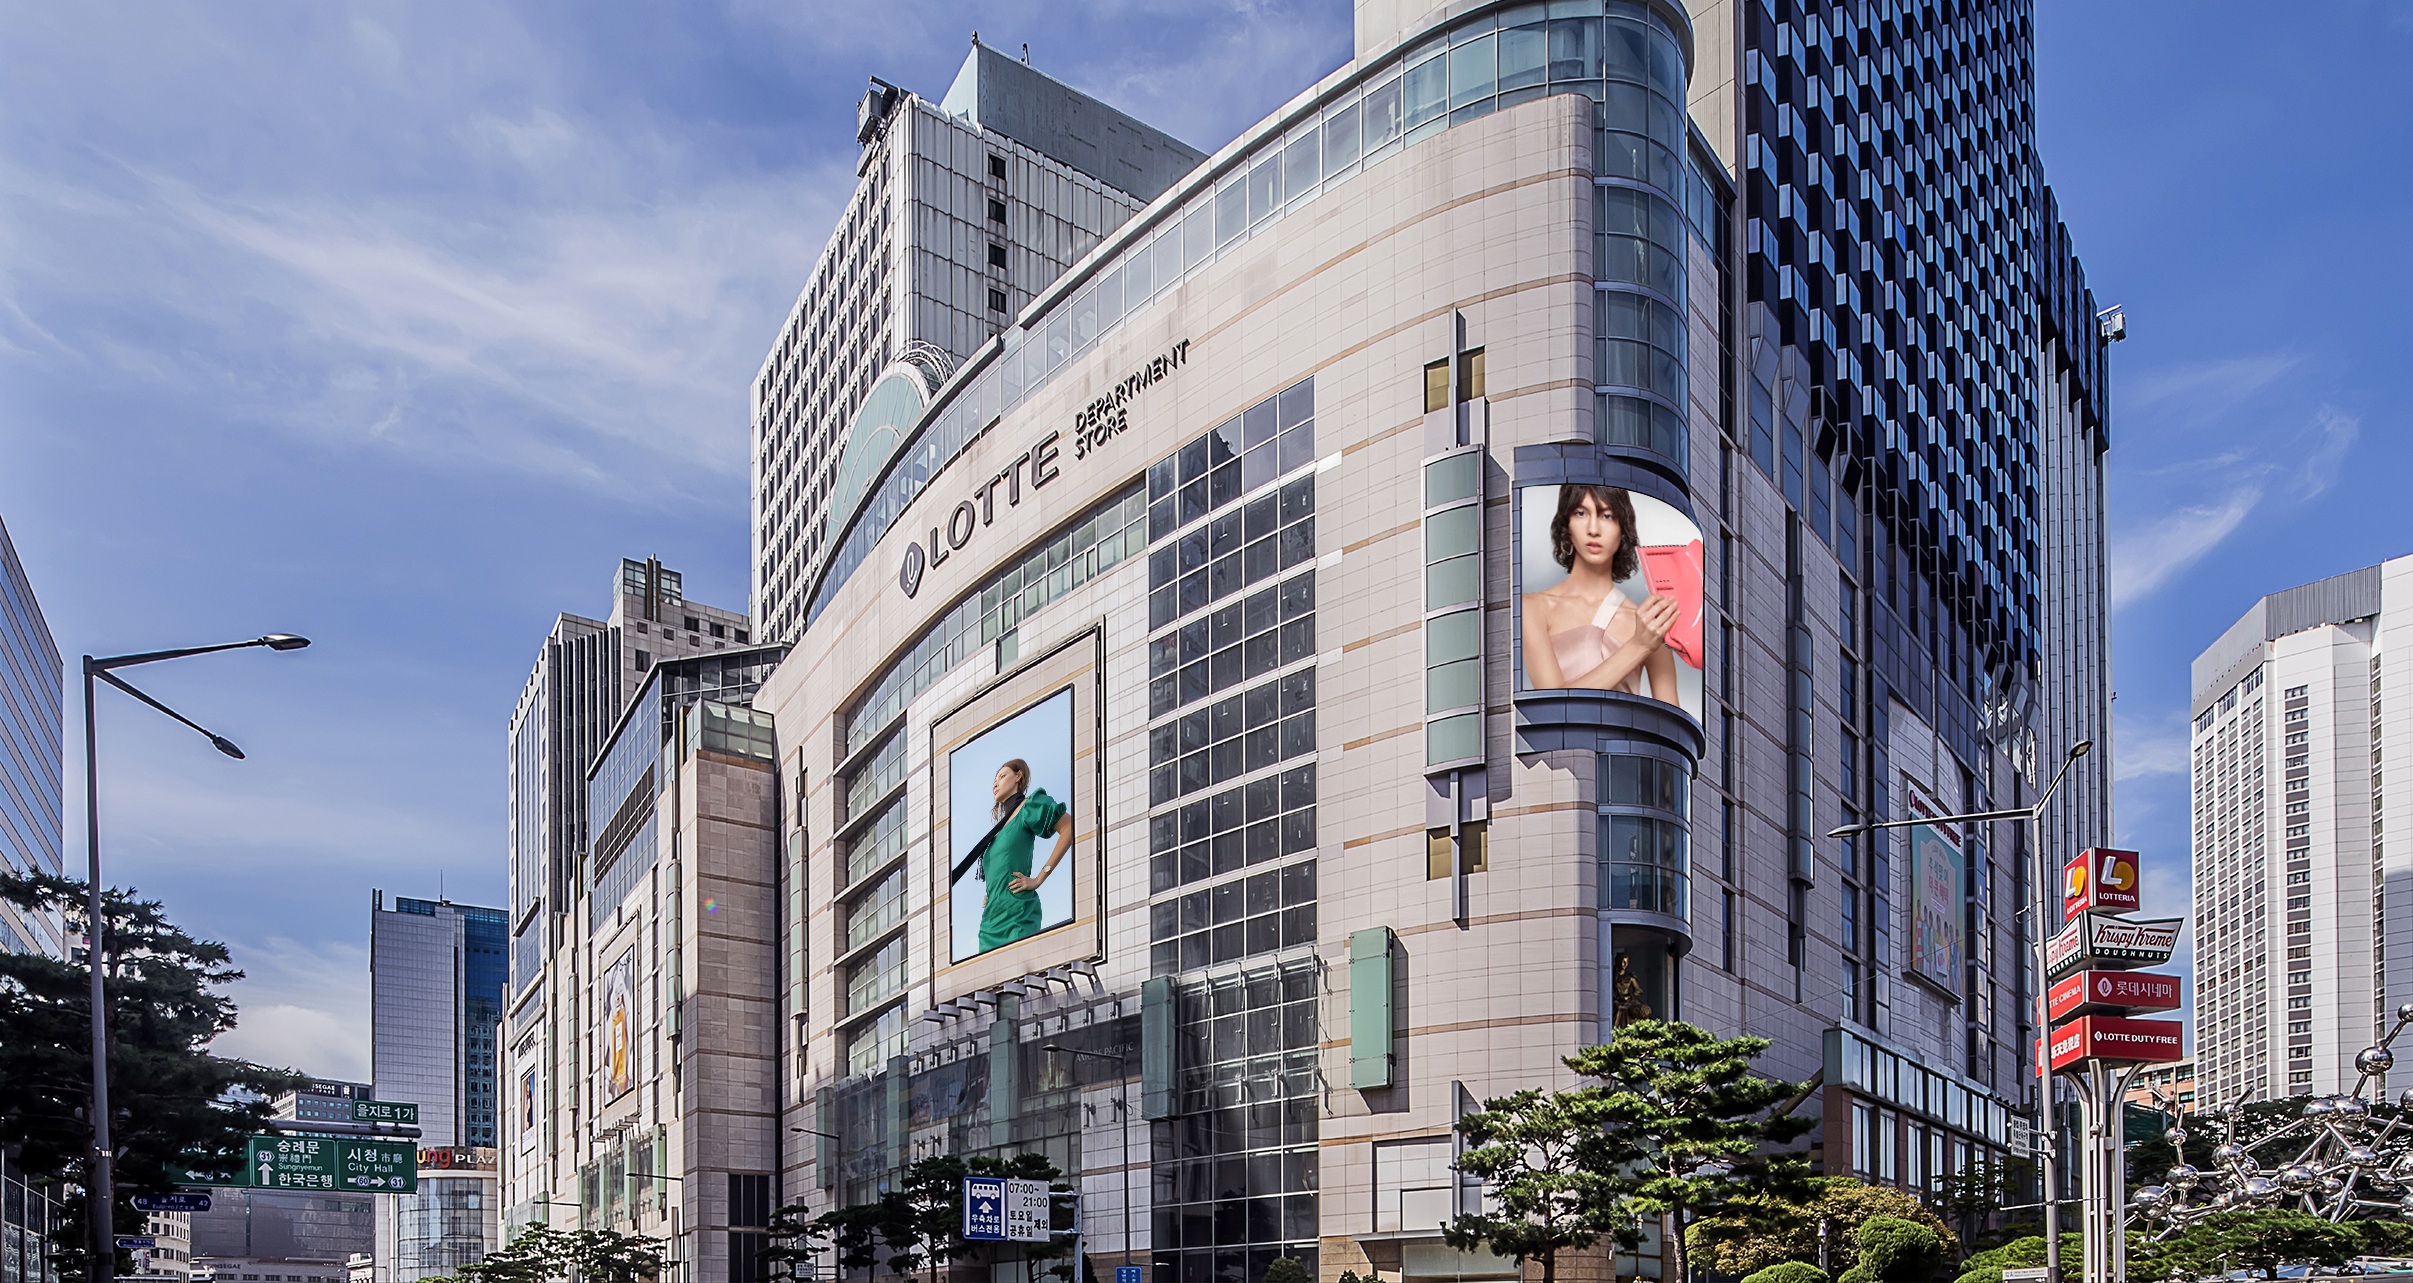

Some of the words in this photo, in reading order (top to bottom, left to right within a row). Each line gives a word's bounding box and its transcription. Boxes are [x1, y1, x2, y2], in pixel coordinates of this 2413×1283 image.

[1074, 338, 1191, 434] DEPARTMENT
[1074, 407, 1128, 460] STORE
[929, 429, 1060, 570] LOTTE
[2099, 892, 2136, 902] LOTTERIA
[2067, 895, 2088, 914] LOTTERIA
[2094, 923, 2135, 948] Krispy
[2134, 926, 2173, 948] Kreme
[2058, 935, 2080, 958] Kreme
[2059, 985, 2081, 1003] CINEMA
[2116, 981, 2173, 998] 롯데시네마
[2104, 1033, 2131, 1042] LOTTE
[2131, 1035, 2156, 1043] DUTY
[2156, 1035, 2178, 1044] FREE
[1104, 1041, 1134, 1055] PACIFIC
[277, 1140, 320, 1154] 숭례문
[260, 1152, 271, 1161] 31
[278, 1154, 312, 1164] 崇禮門
[347, 1148, 377, 1162] 시청
[278, 1163, 323, 1172] Sungnyemun
[348, 1162, 369, 1174] City
[374, 1163, 393, 1173] Hall
[278, 1173, 333, 1188] 한국은행
[358, 1176, 368, 1185] 60
[391, 1178, 402, 1187] 31
[137, 1197, 148, 1205] 48
[1023, 1197, 1048, 1207] 21:00
[971, 1214, 1000, 1223] 우측차로
[1009, 1210, 1033, 1222] 토요일
[971, 1224, 1000, 1234] 버스전용
[1034, 1219, 1048, 1230] 제외
[1009, 1225, 1033, 1237] 공휴일
